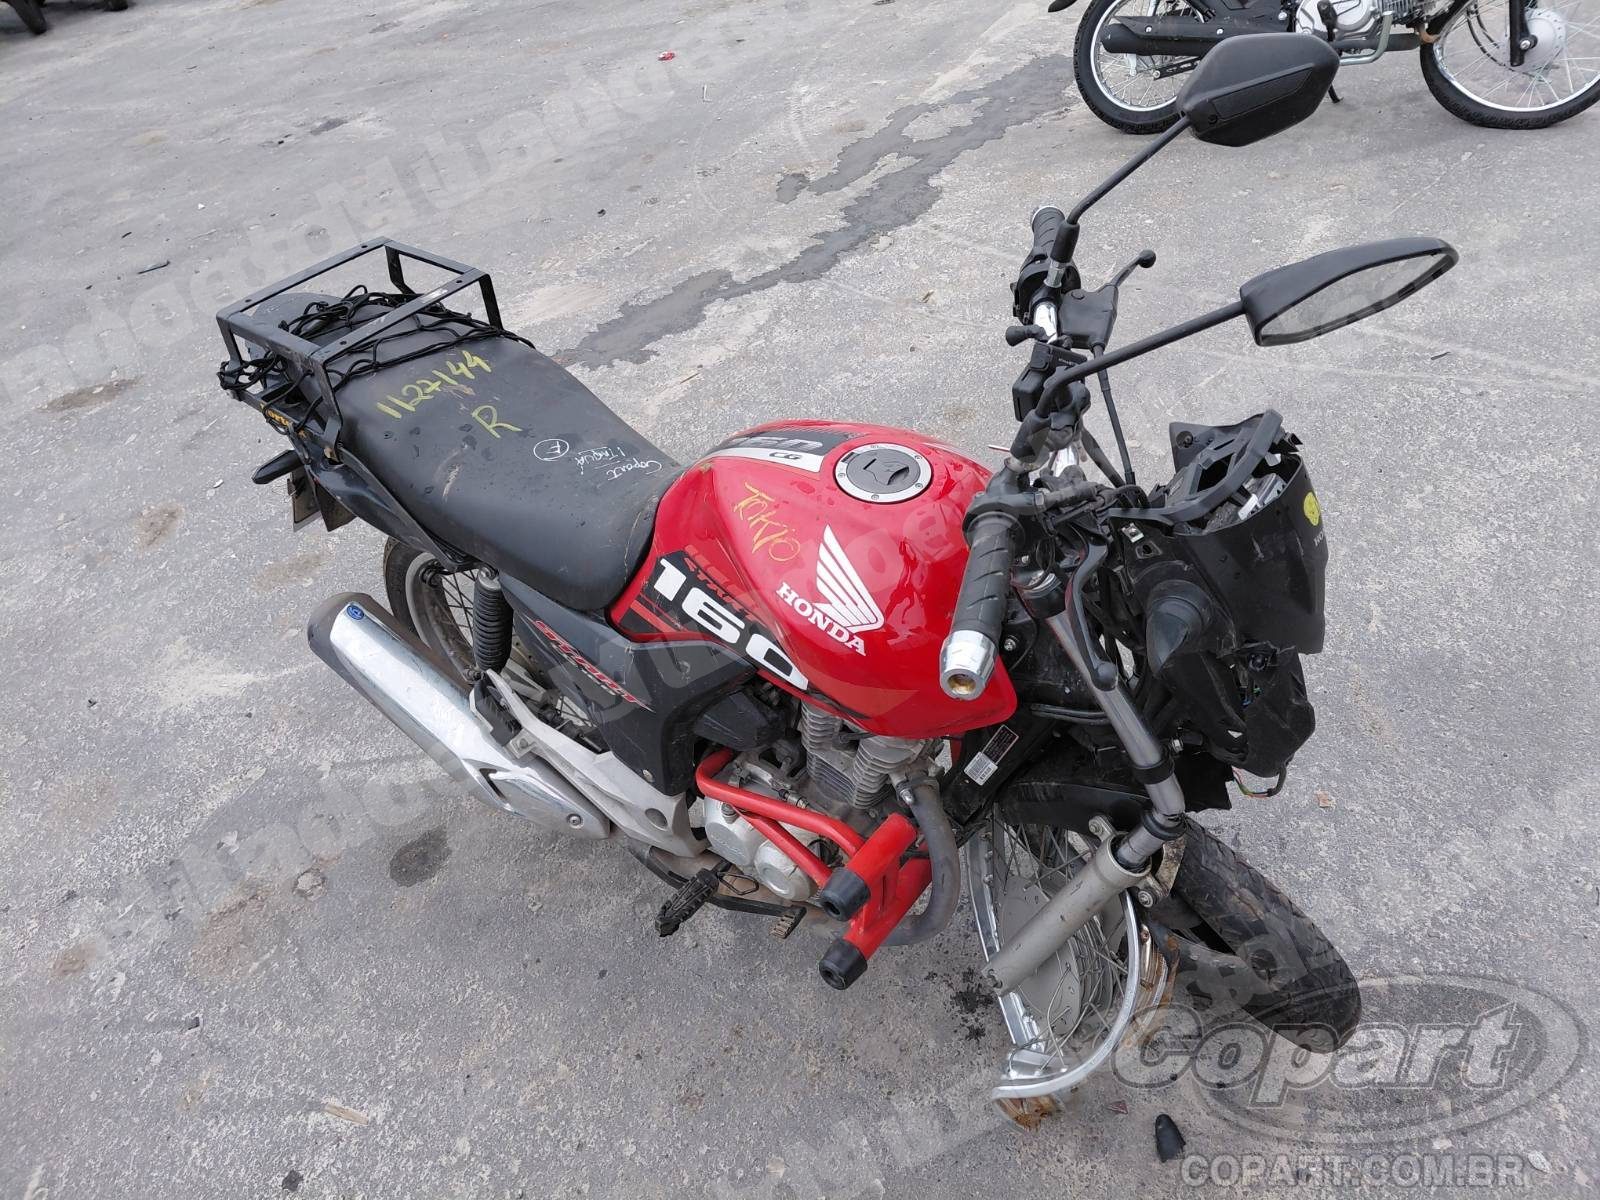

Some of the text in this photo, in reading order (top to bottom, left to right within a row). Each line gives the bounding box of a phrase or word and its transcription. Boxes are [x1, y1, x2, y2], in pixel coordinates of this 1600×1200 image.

[471, 405, 523, 438] R
[653, 557, 809, 691] 160
[776, 582, 867, 657] HONDA
